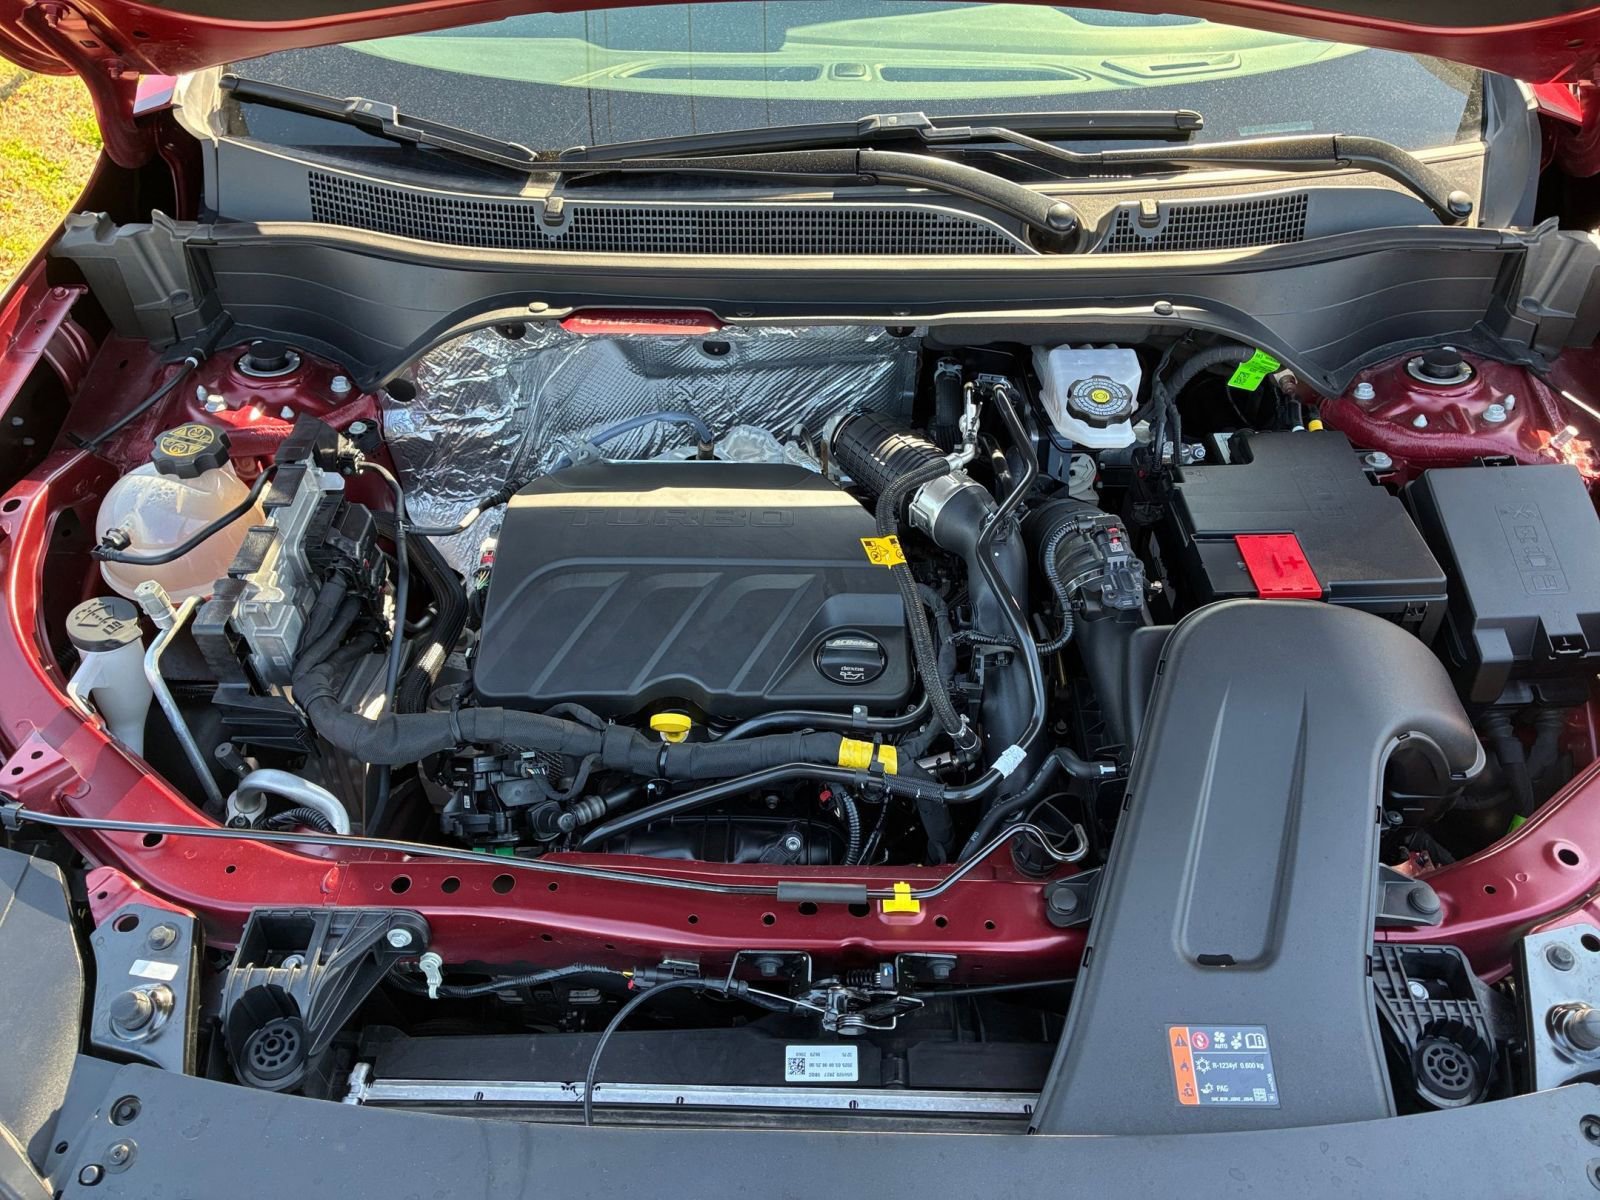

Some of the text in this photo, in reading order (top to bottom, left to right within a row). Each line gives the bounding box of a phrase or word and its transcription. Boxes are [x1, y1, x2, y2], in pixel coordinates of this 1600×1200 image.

[560, 510, 795, 527] TURBO
[832, 639, 873, 647] ACDelco
[1212, 1062, 1237, 1070] R-1234yf
